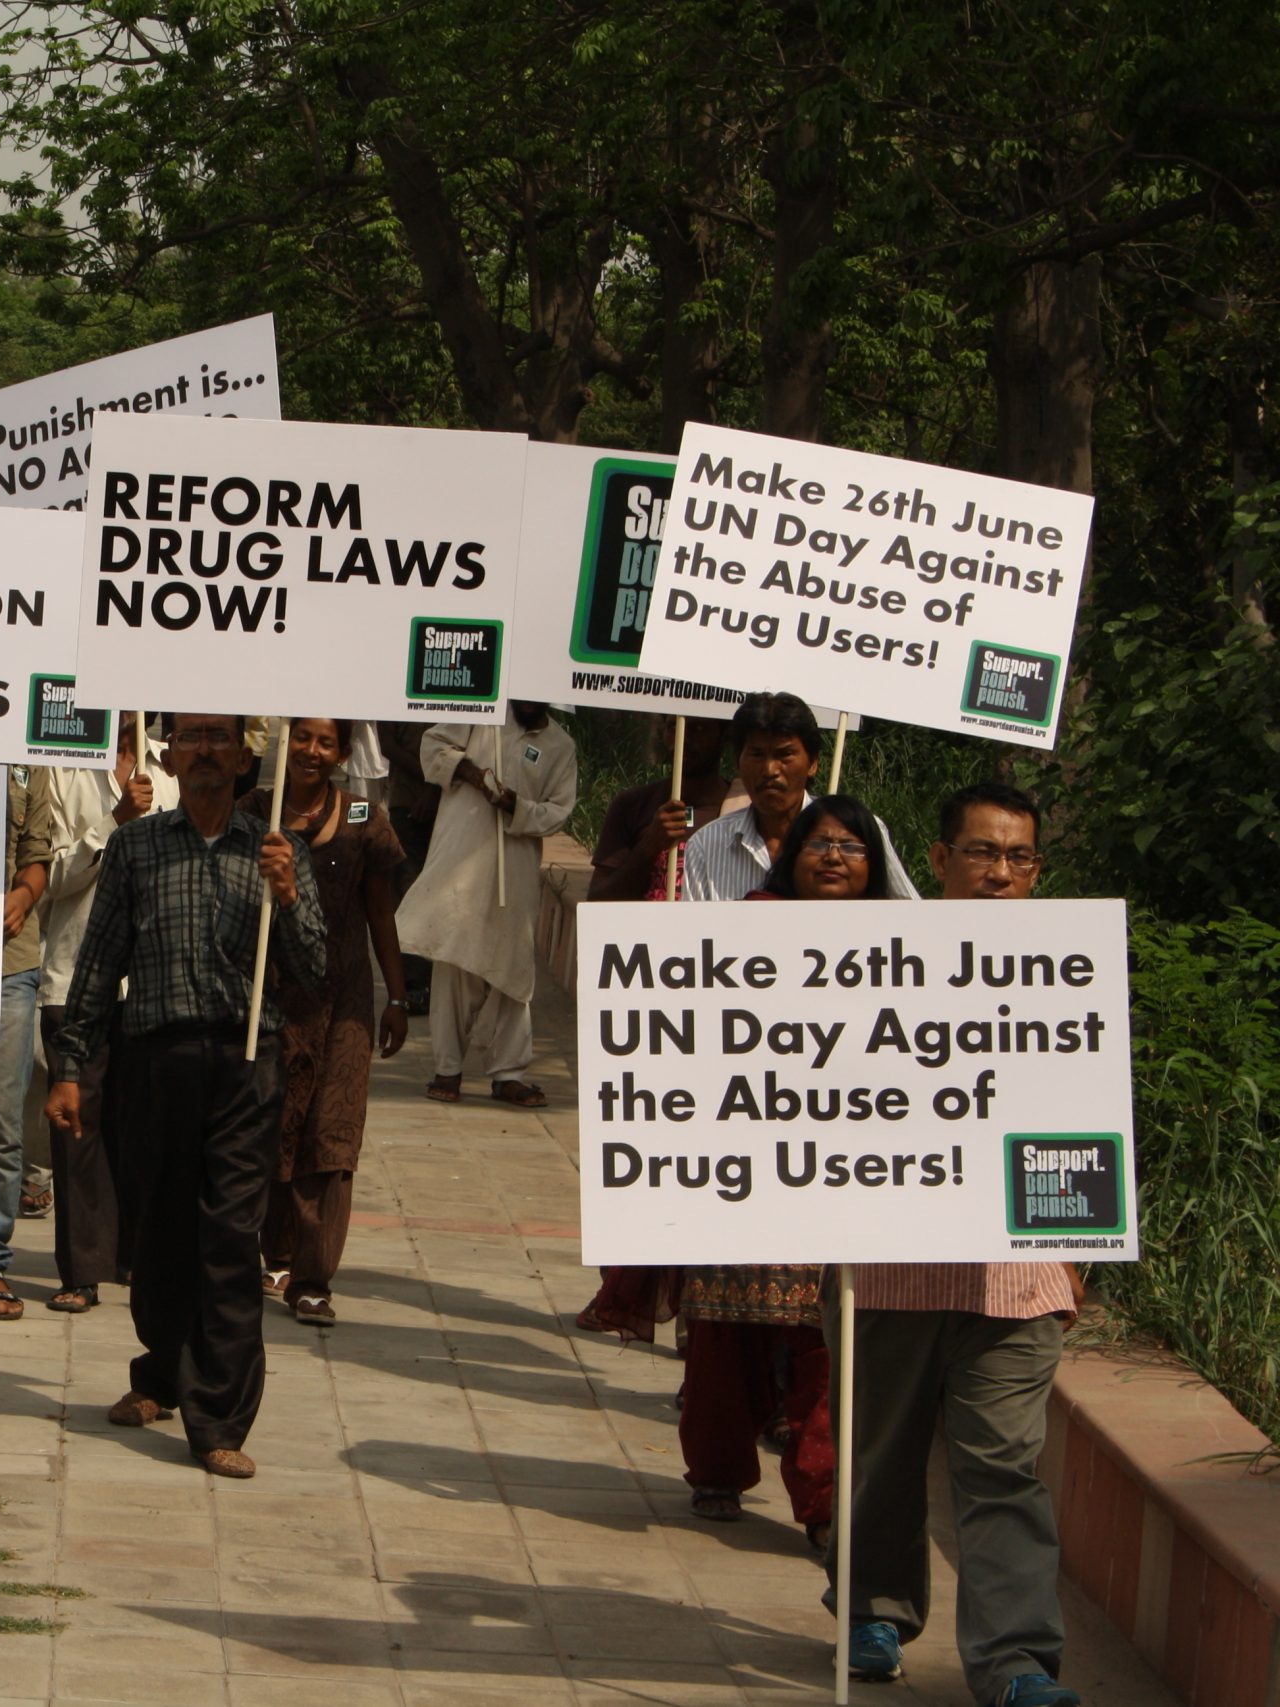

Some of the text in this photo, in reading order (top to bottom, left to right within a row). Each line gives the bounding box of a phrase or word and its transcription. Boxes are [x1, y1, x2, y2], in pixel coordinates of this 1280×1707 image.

[201, 364, 264, 397] is...
[104, 472, 362, 530] REFORM
[691, 454, 1062, 549] Make 26th June
[100, 526, 485, 590] DRUG LAWS
[685, 498, 757, 539] UN
[774, 514, 868, 567] Day
[882, 536, 1062, 596] Against
[97, 580, 287, 633] NOW!
[675, 543, 745, 584] the
[761, 561, 906, 613] Abuse
[924, 593, 974, 625] of
[424, 626, 488, 663] Support.
[666, 589, 779, 648] Drug
[798, 613, 938, 668] Users!
[572, 671, 746, 704] www.supportdontpunis
[983, 650, 1043, 687] Support.
[42, 682, 75, 715] Supp
[599, 938, 1093, 989] Make 26th June
[601, 1005, 1104, 1068] UN Day Against
[599, 1070, 995, 1122] the Abuse of
[603, 1142, 962, 1201] Drug Users!
[1023, 1145, 1105, 1189] Support.
